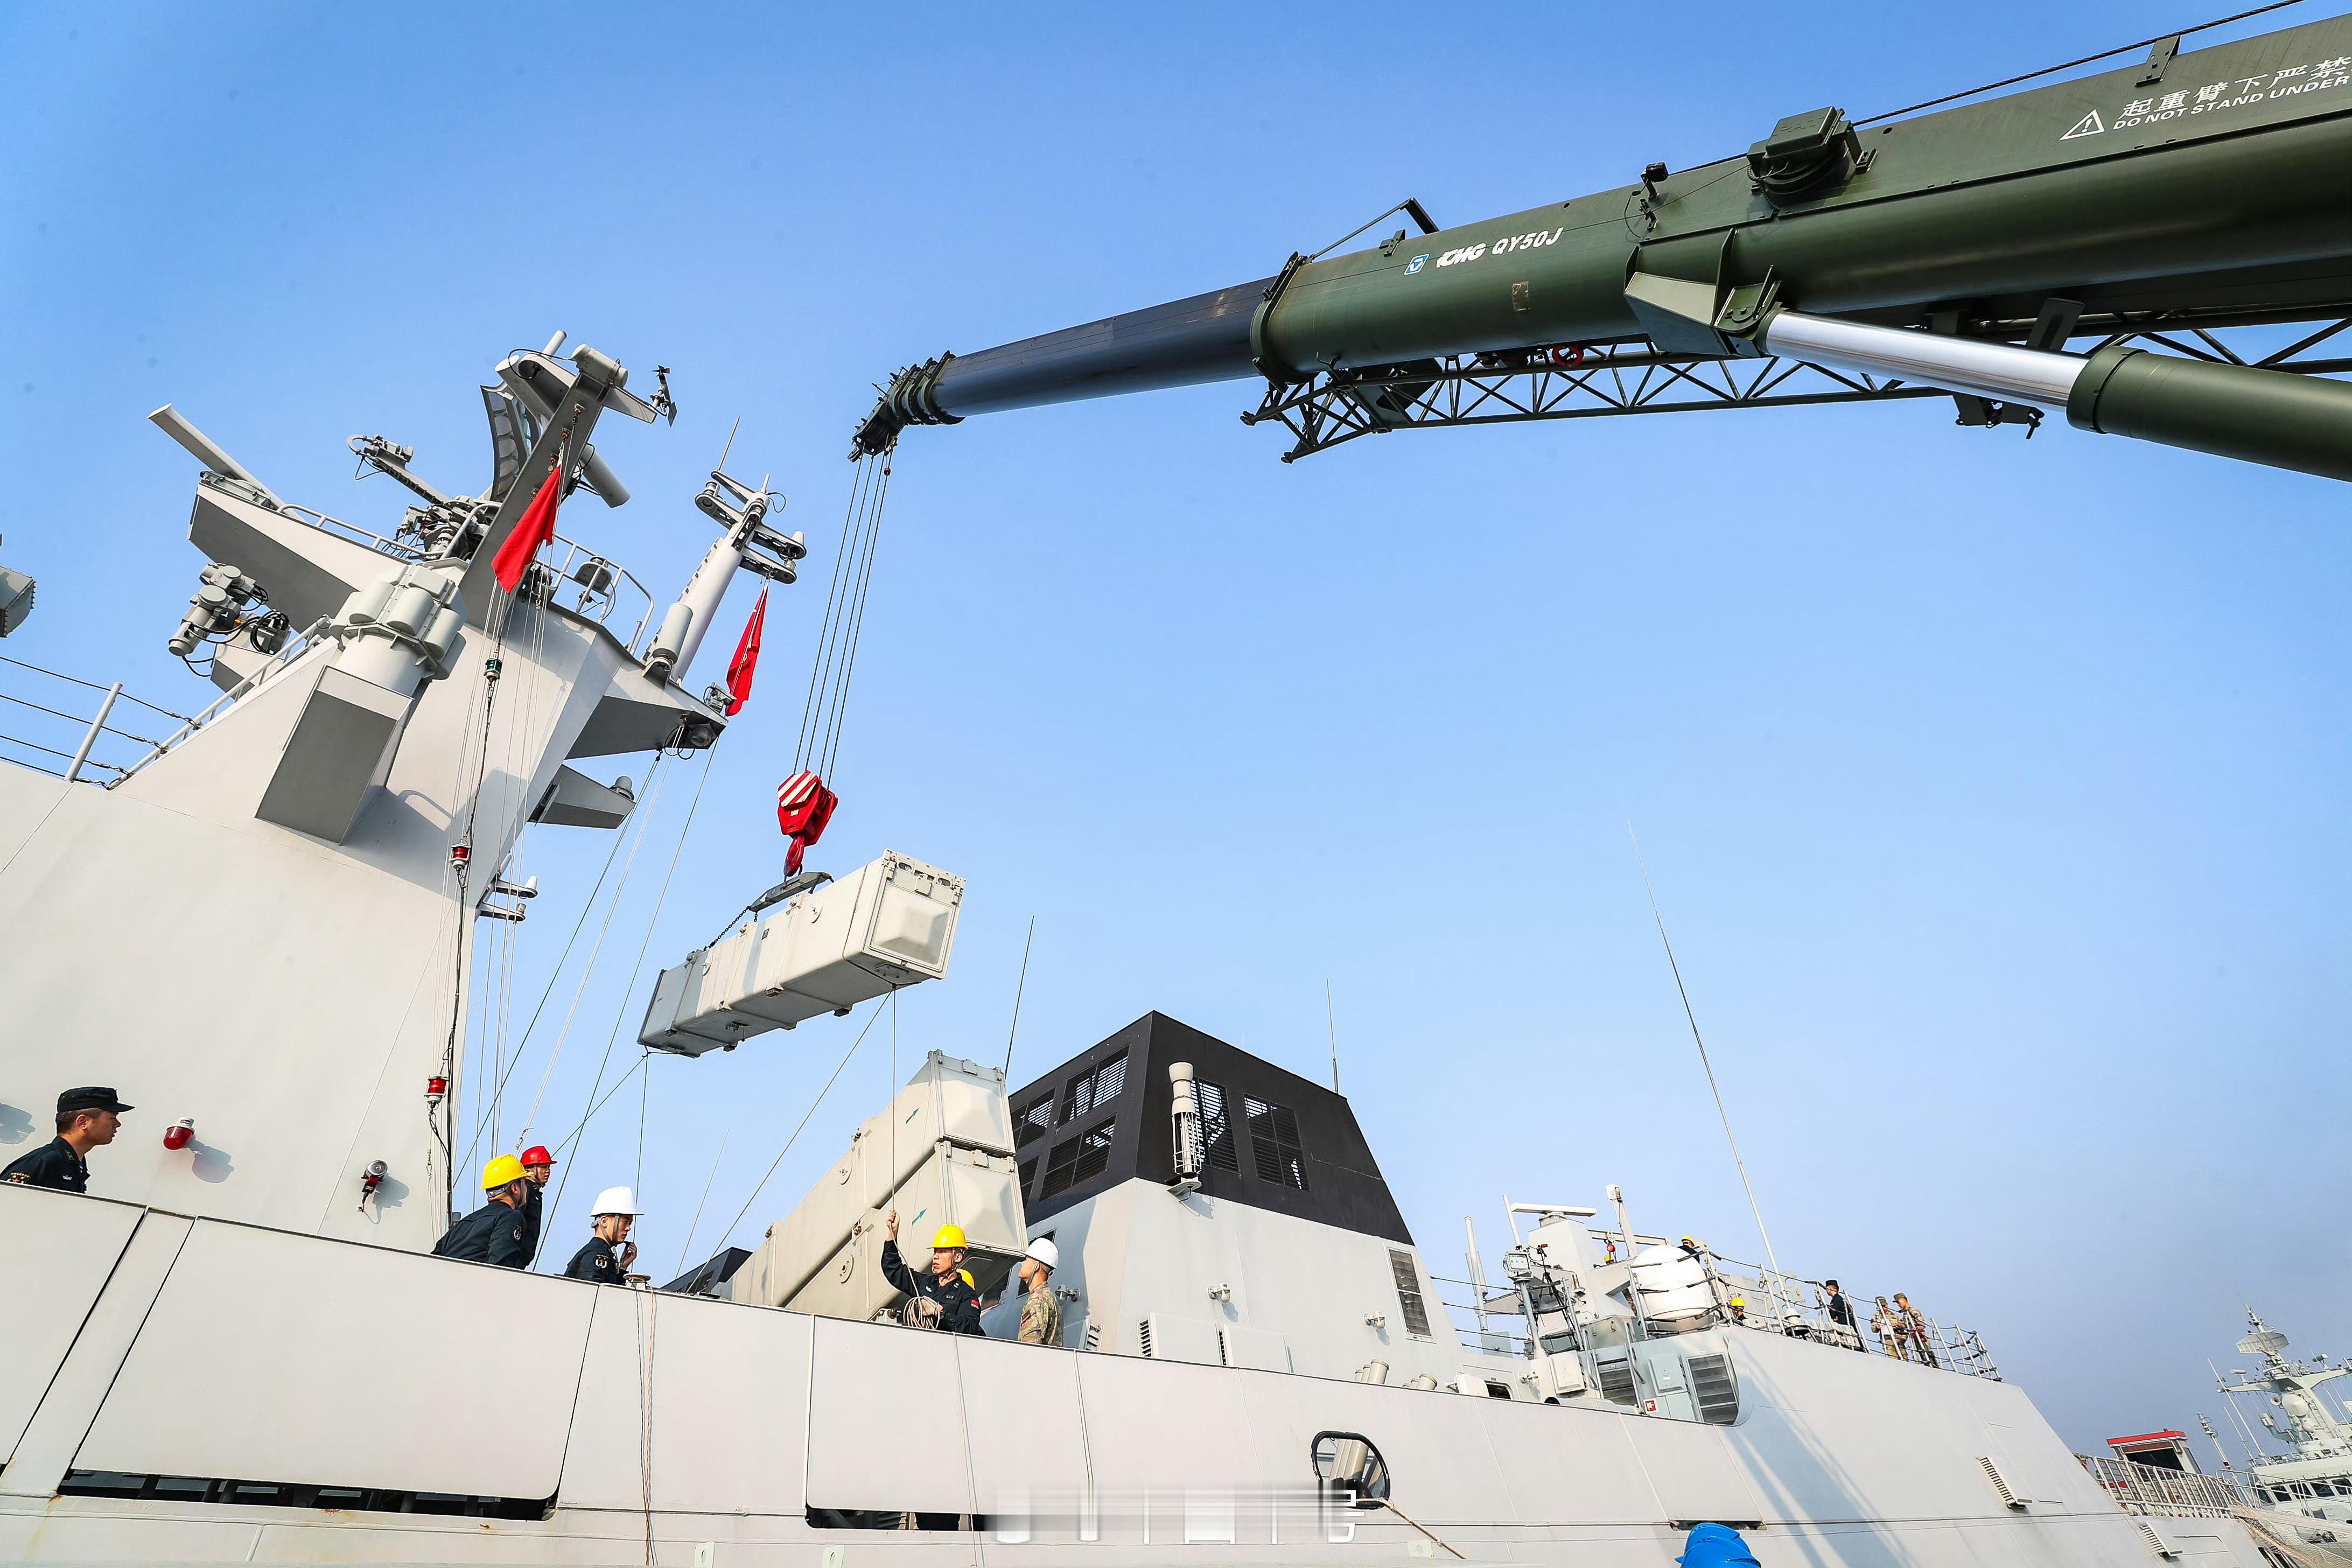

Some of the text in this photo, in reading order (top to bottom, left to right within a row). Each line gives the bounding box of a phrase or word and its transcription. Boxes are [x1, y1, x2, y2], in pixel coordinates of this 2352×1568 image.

[2112, 75, 2350, 130] DO NOT STAND UNDER
[2118, 56, 2352, 120] 起重臂下严禁
[1491, 226, 1564, 255] QY50J
